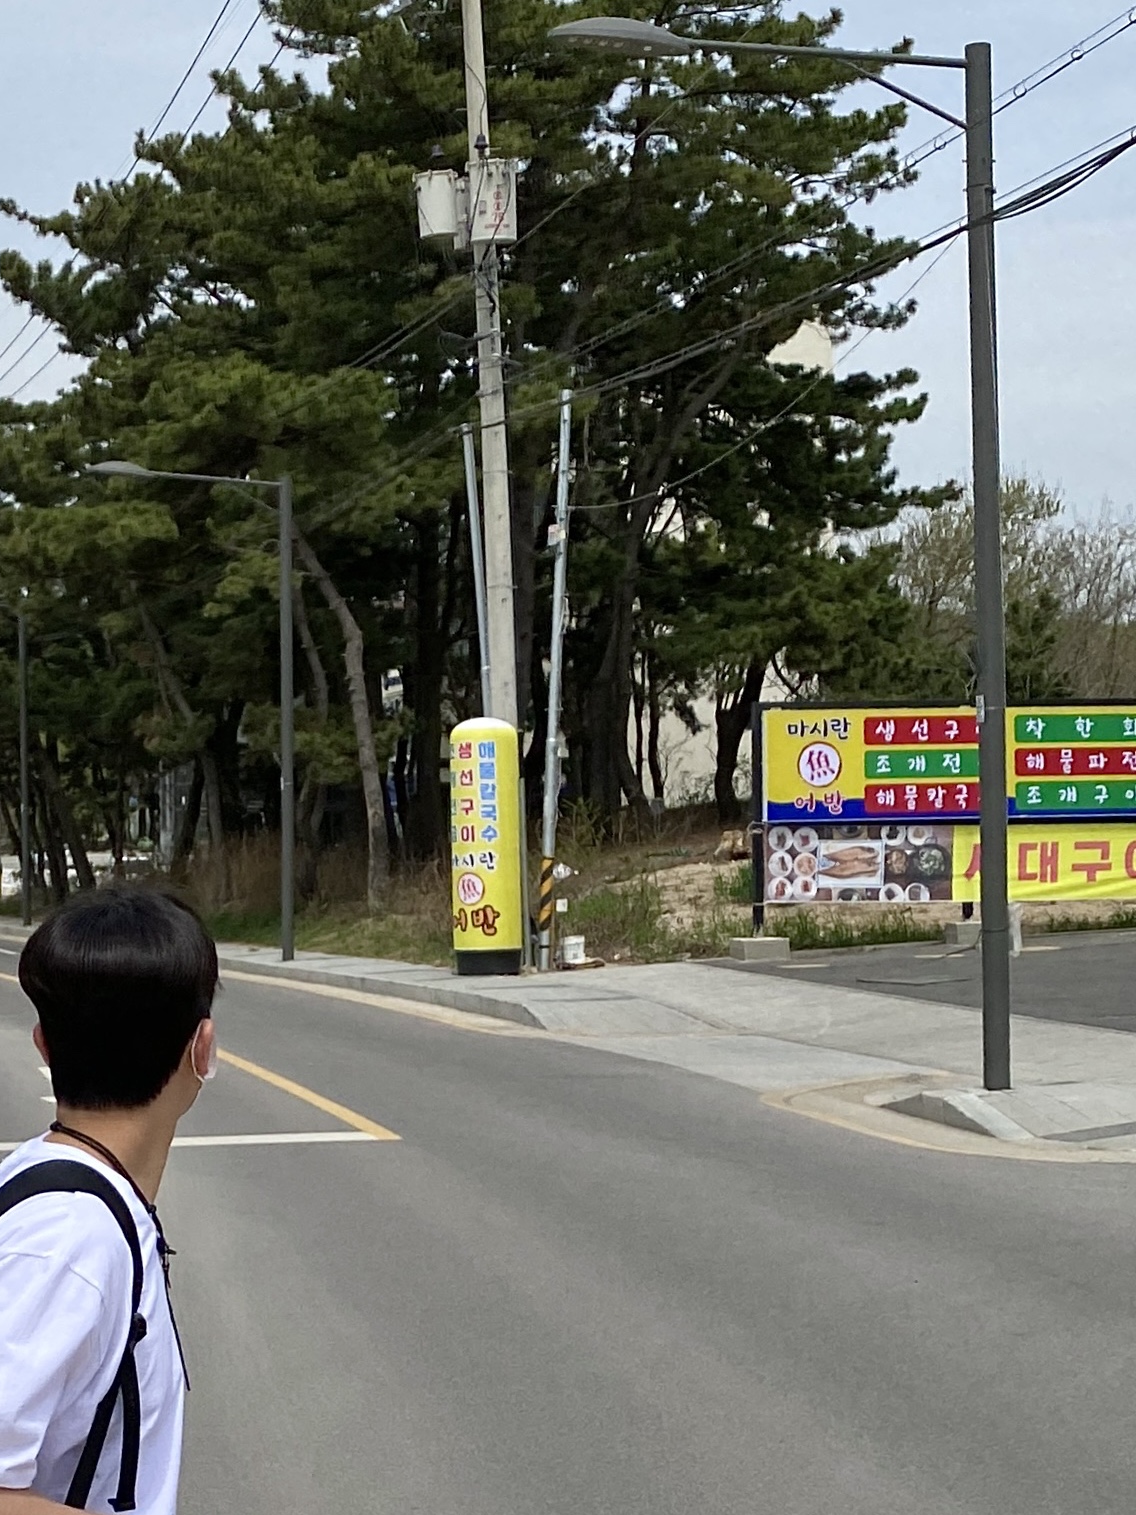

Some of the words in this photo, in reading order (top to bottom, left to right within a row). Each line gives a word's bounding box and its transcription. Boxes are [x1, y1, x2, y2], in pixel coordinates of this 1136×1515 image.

[787, 716, 851, 740] 마시란
[875, 718, 979, 742] 생선구
[875, 752, 979, 774] 조개전
[458, 741, 476, 843] 생선구이
[875, 783, 979, 811] 해물칼국
